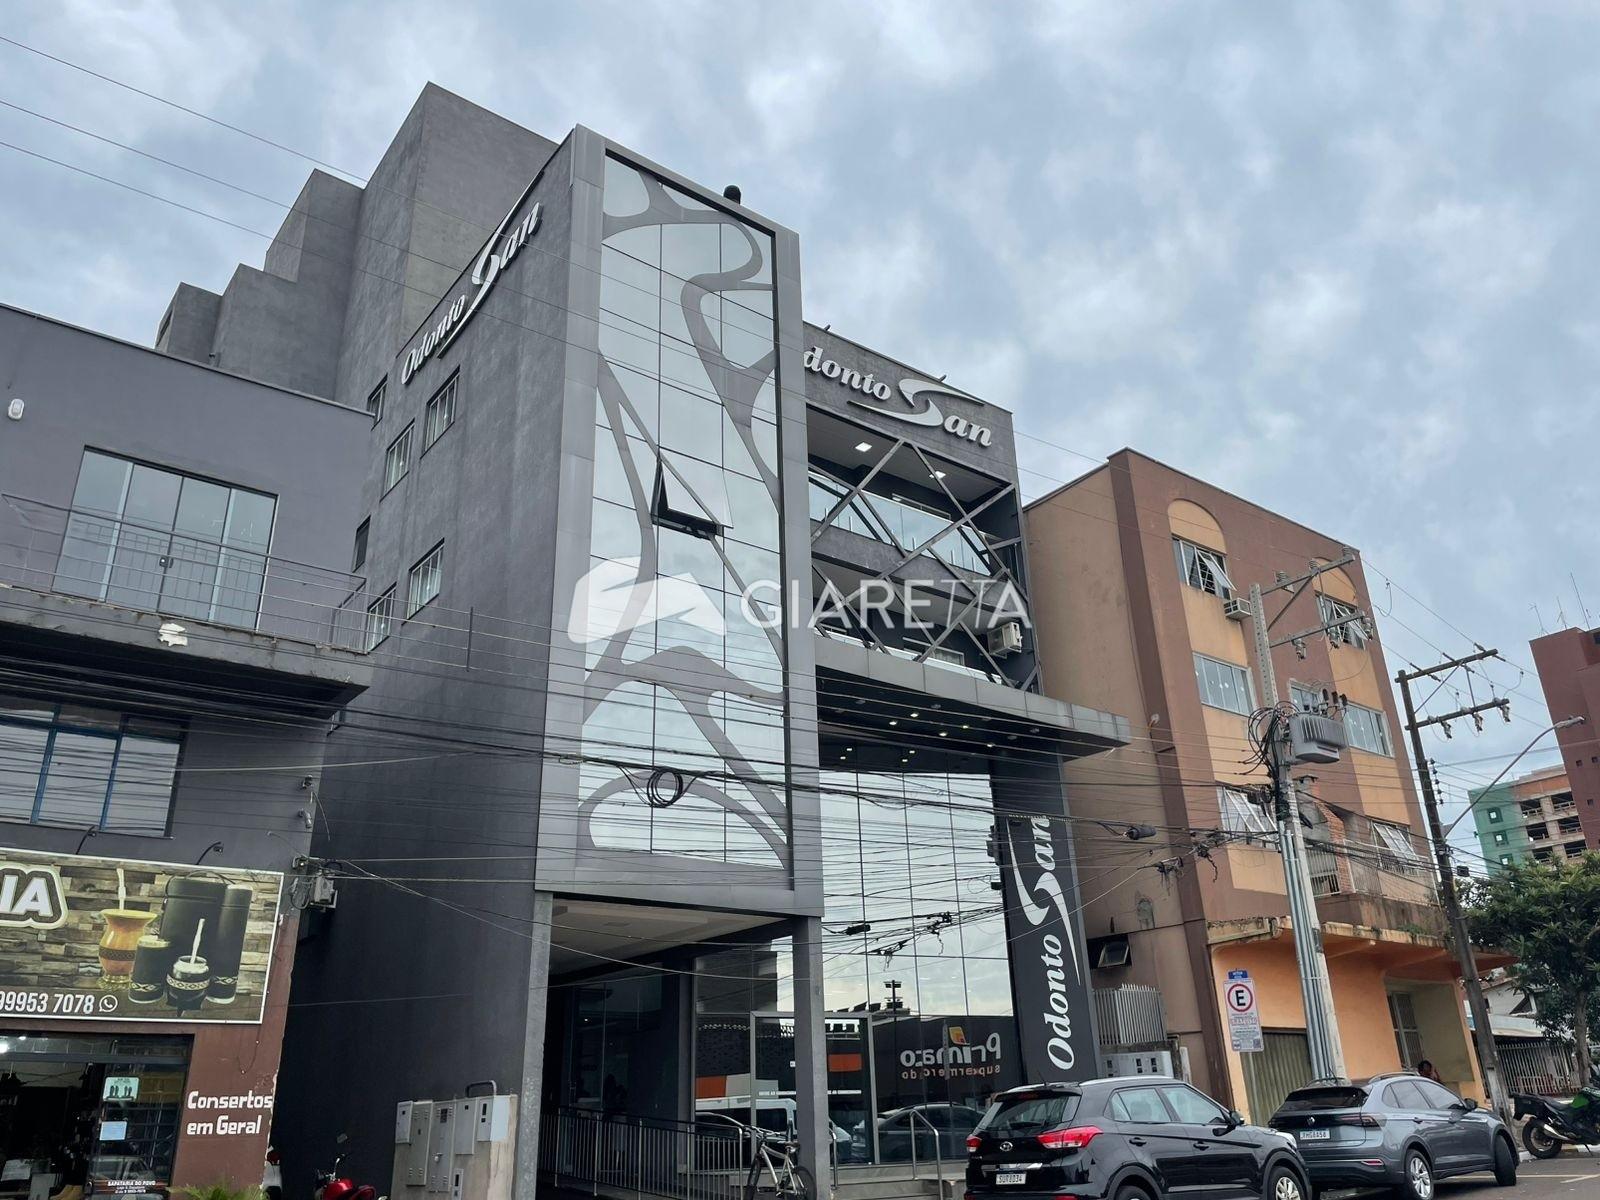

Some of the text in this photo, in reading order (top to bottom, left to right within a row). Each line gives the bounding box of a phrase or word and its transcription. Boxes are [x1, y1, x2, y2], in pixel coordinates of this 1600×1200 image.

[401, 294, 466, 386] Odonto
[803, 346, 992, 447] donto San
[1006, 816, 1081, 1070] San Odonto
[53, 994, 94, 1014] 7078
[1235, 989, 1246, 1007] E
[188, 1090, 273, 1109] Consertos
[187, 1115, 262, 1135] em Geral
